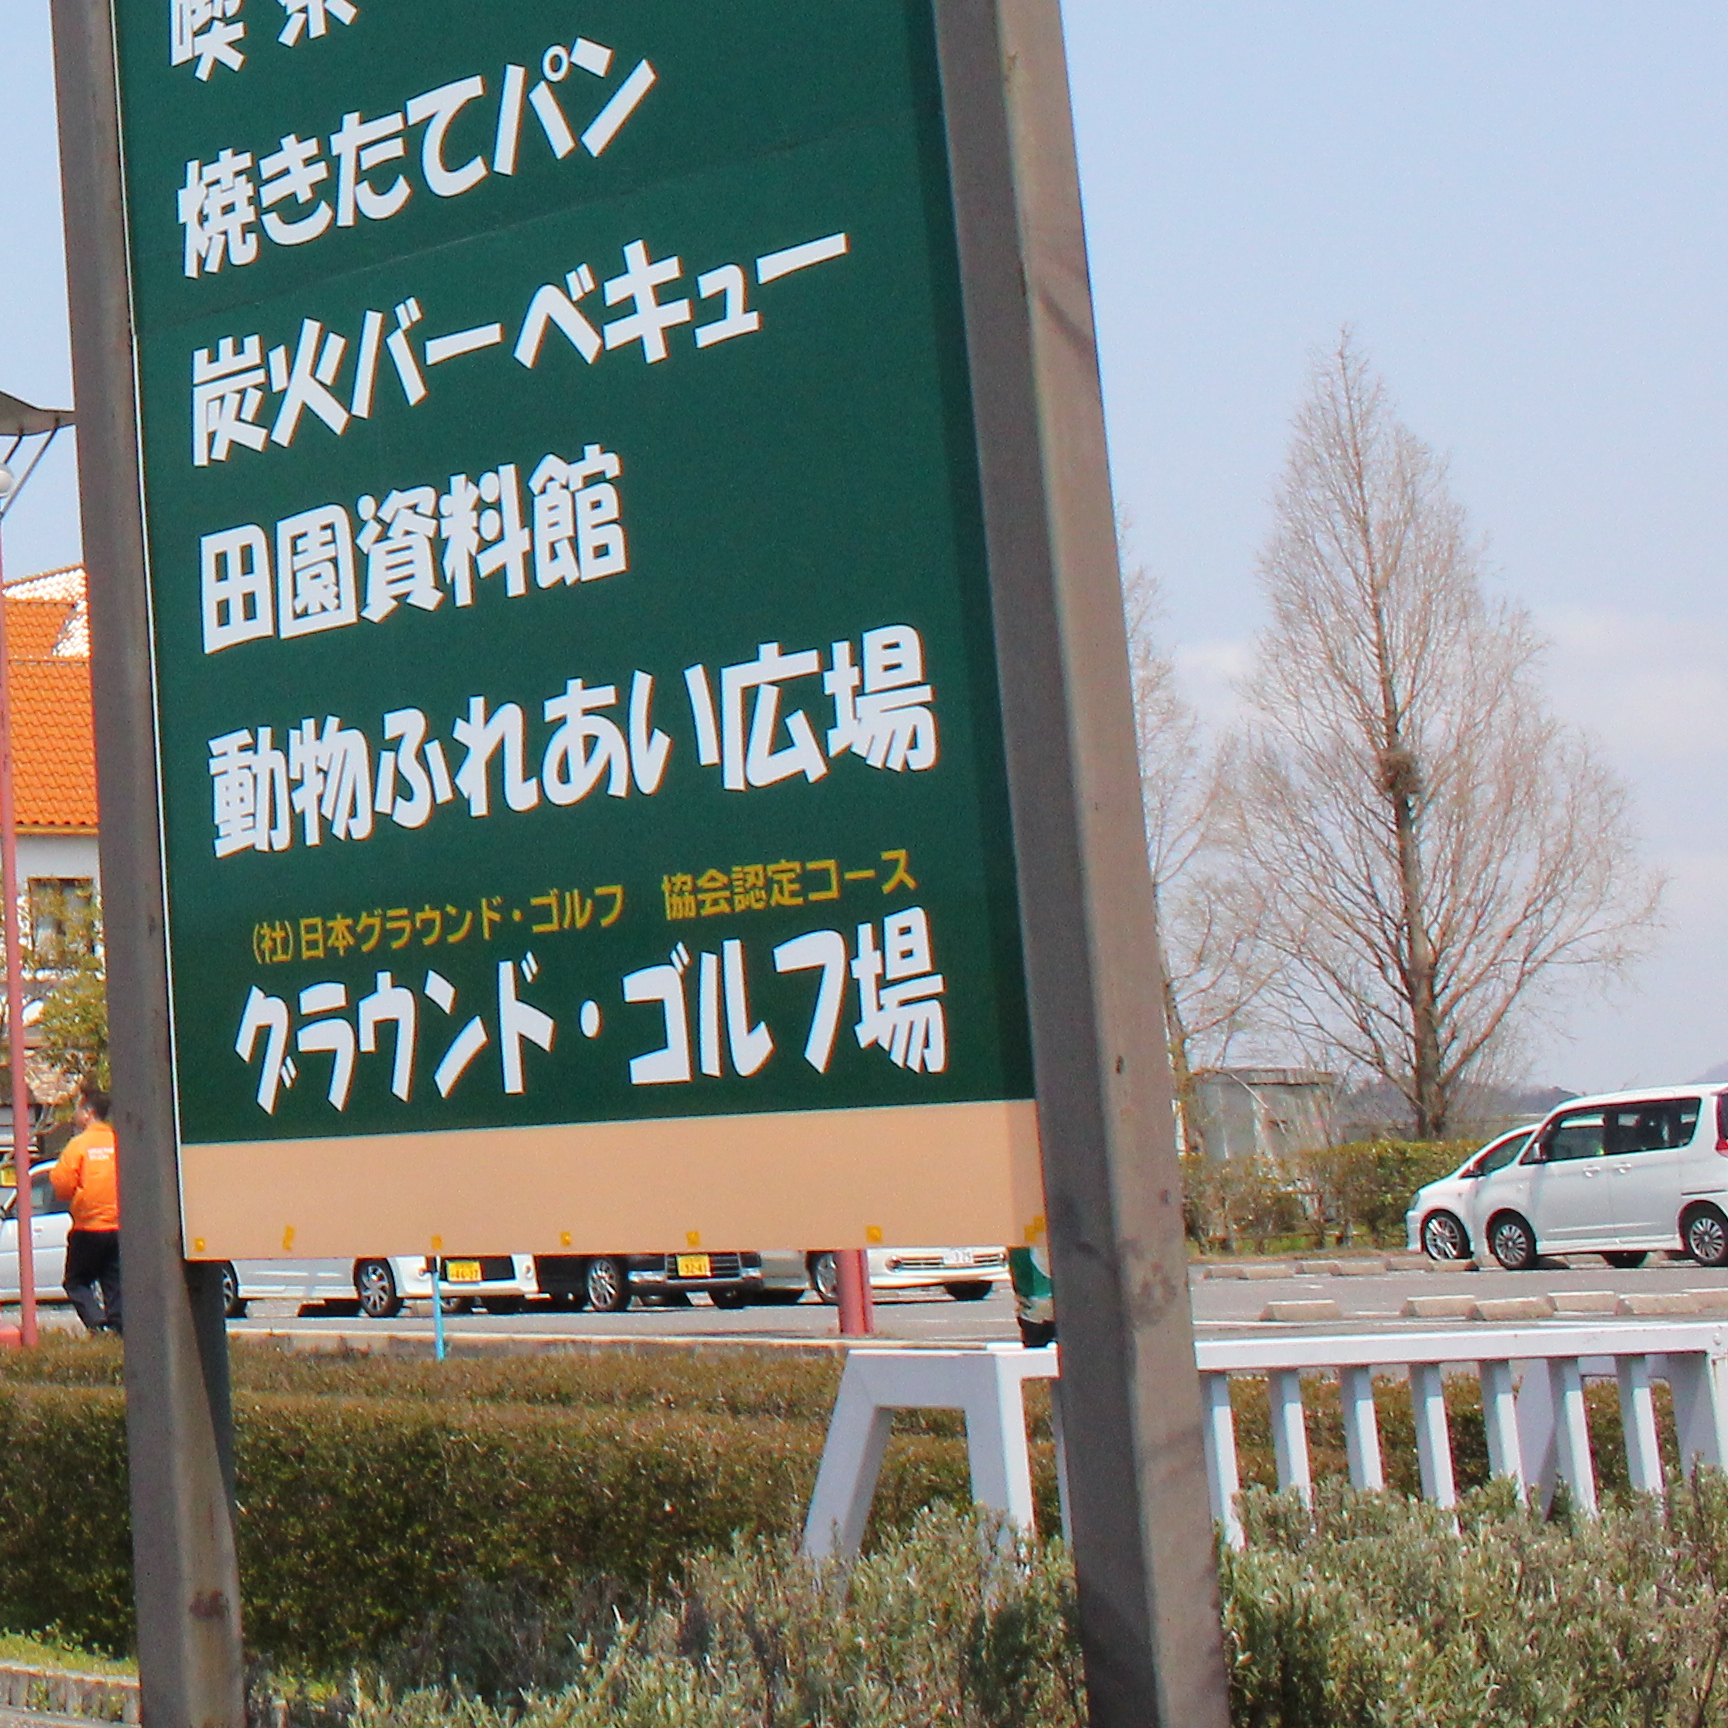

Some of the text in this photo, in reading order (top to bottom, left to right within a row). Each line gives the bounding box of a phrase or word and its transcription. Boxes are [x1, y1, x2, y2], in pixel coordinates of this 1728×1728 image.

[176, 36, 656, 279] 焼きたてパン
[192, 233, 848, 467] 炭火バーベキュー
[200, 444, 627, 654] 田園資料館
[209, 623, 938, 860] 動物ふれあい広場
[661, 848, 918, 920] 協会認定コース
[234, 906, 948, 1115] グラウンド・ゴルフ場
